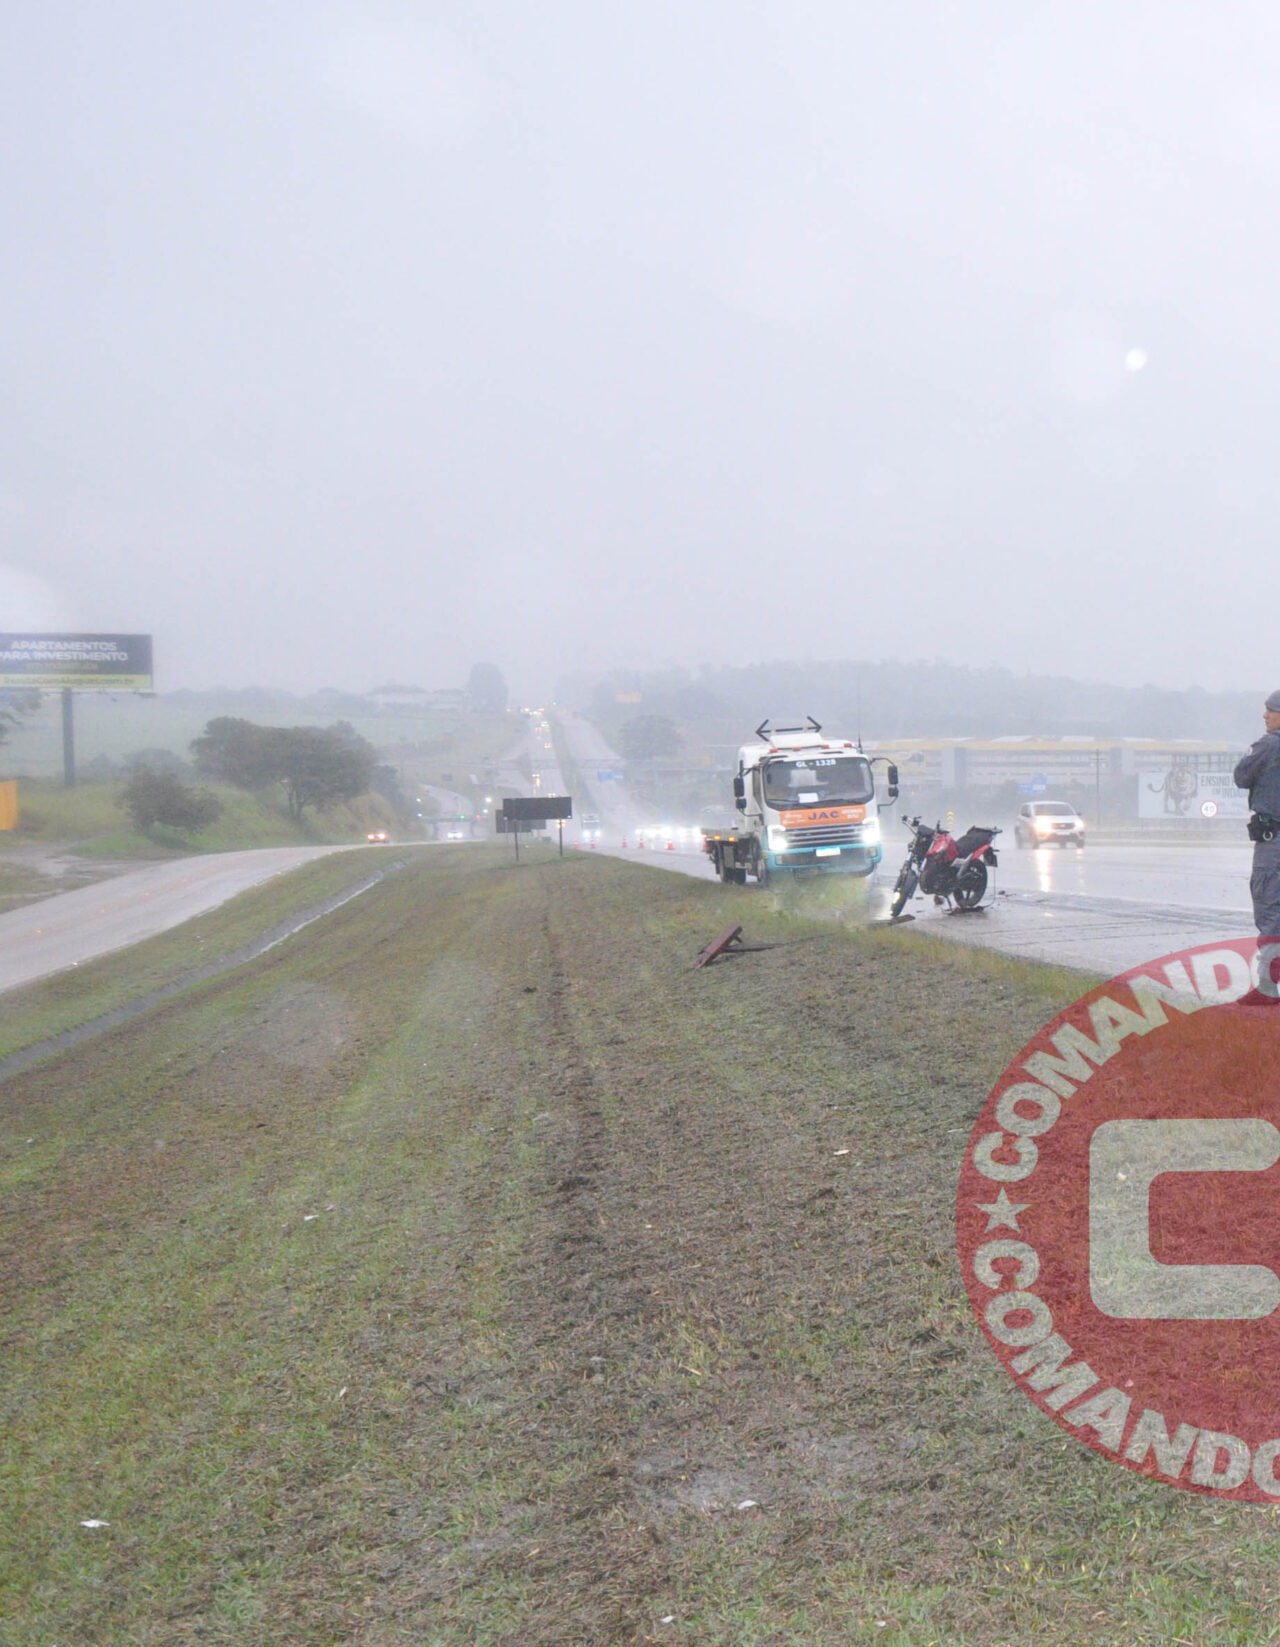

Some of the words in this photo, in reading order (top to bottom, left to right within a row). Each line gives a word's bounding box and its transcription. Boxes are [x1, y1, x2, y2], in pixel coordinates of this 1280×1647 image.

[10, 640, 118, 651] APARTAMENTOS
[33, 651, 129, 661] INVESTIMENTO
[815, 759, 837, 767] 1328
[808, 810, 840, 821] JAC
